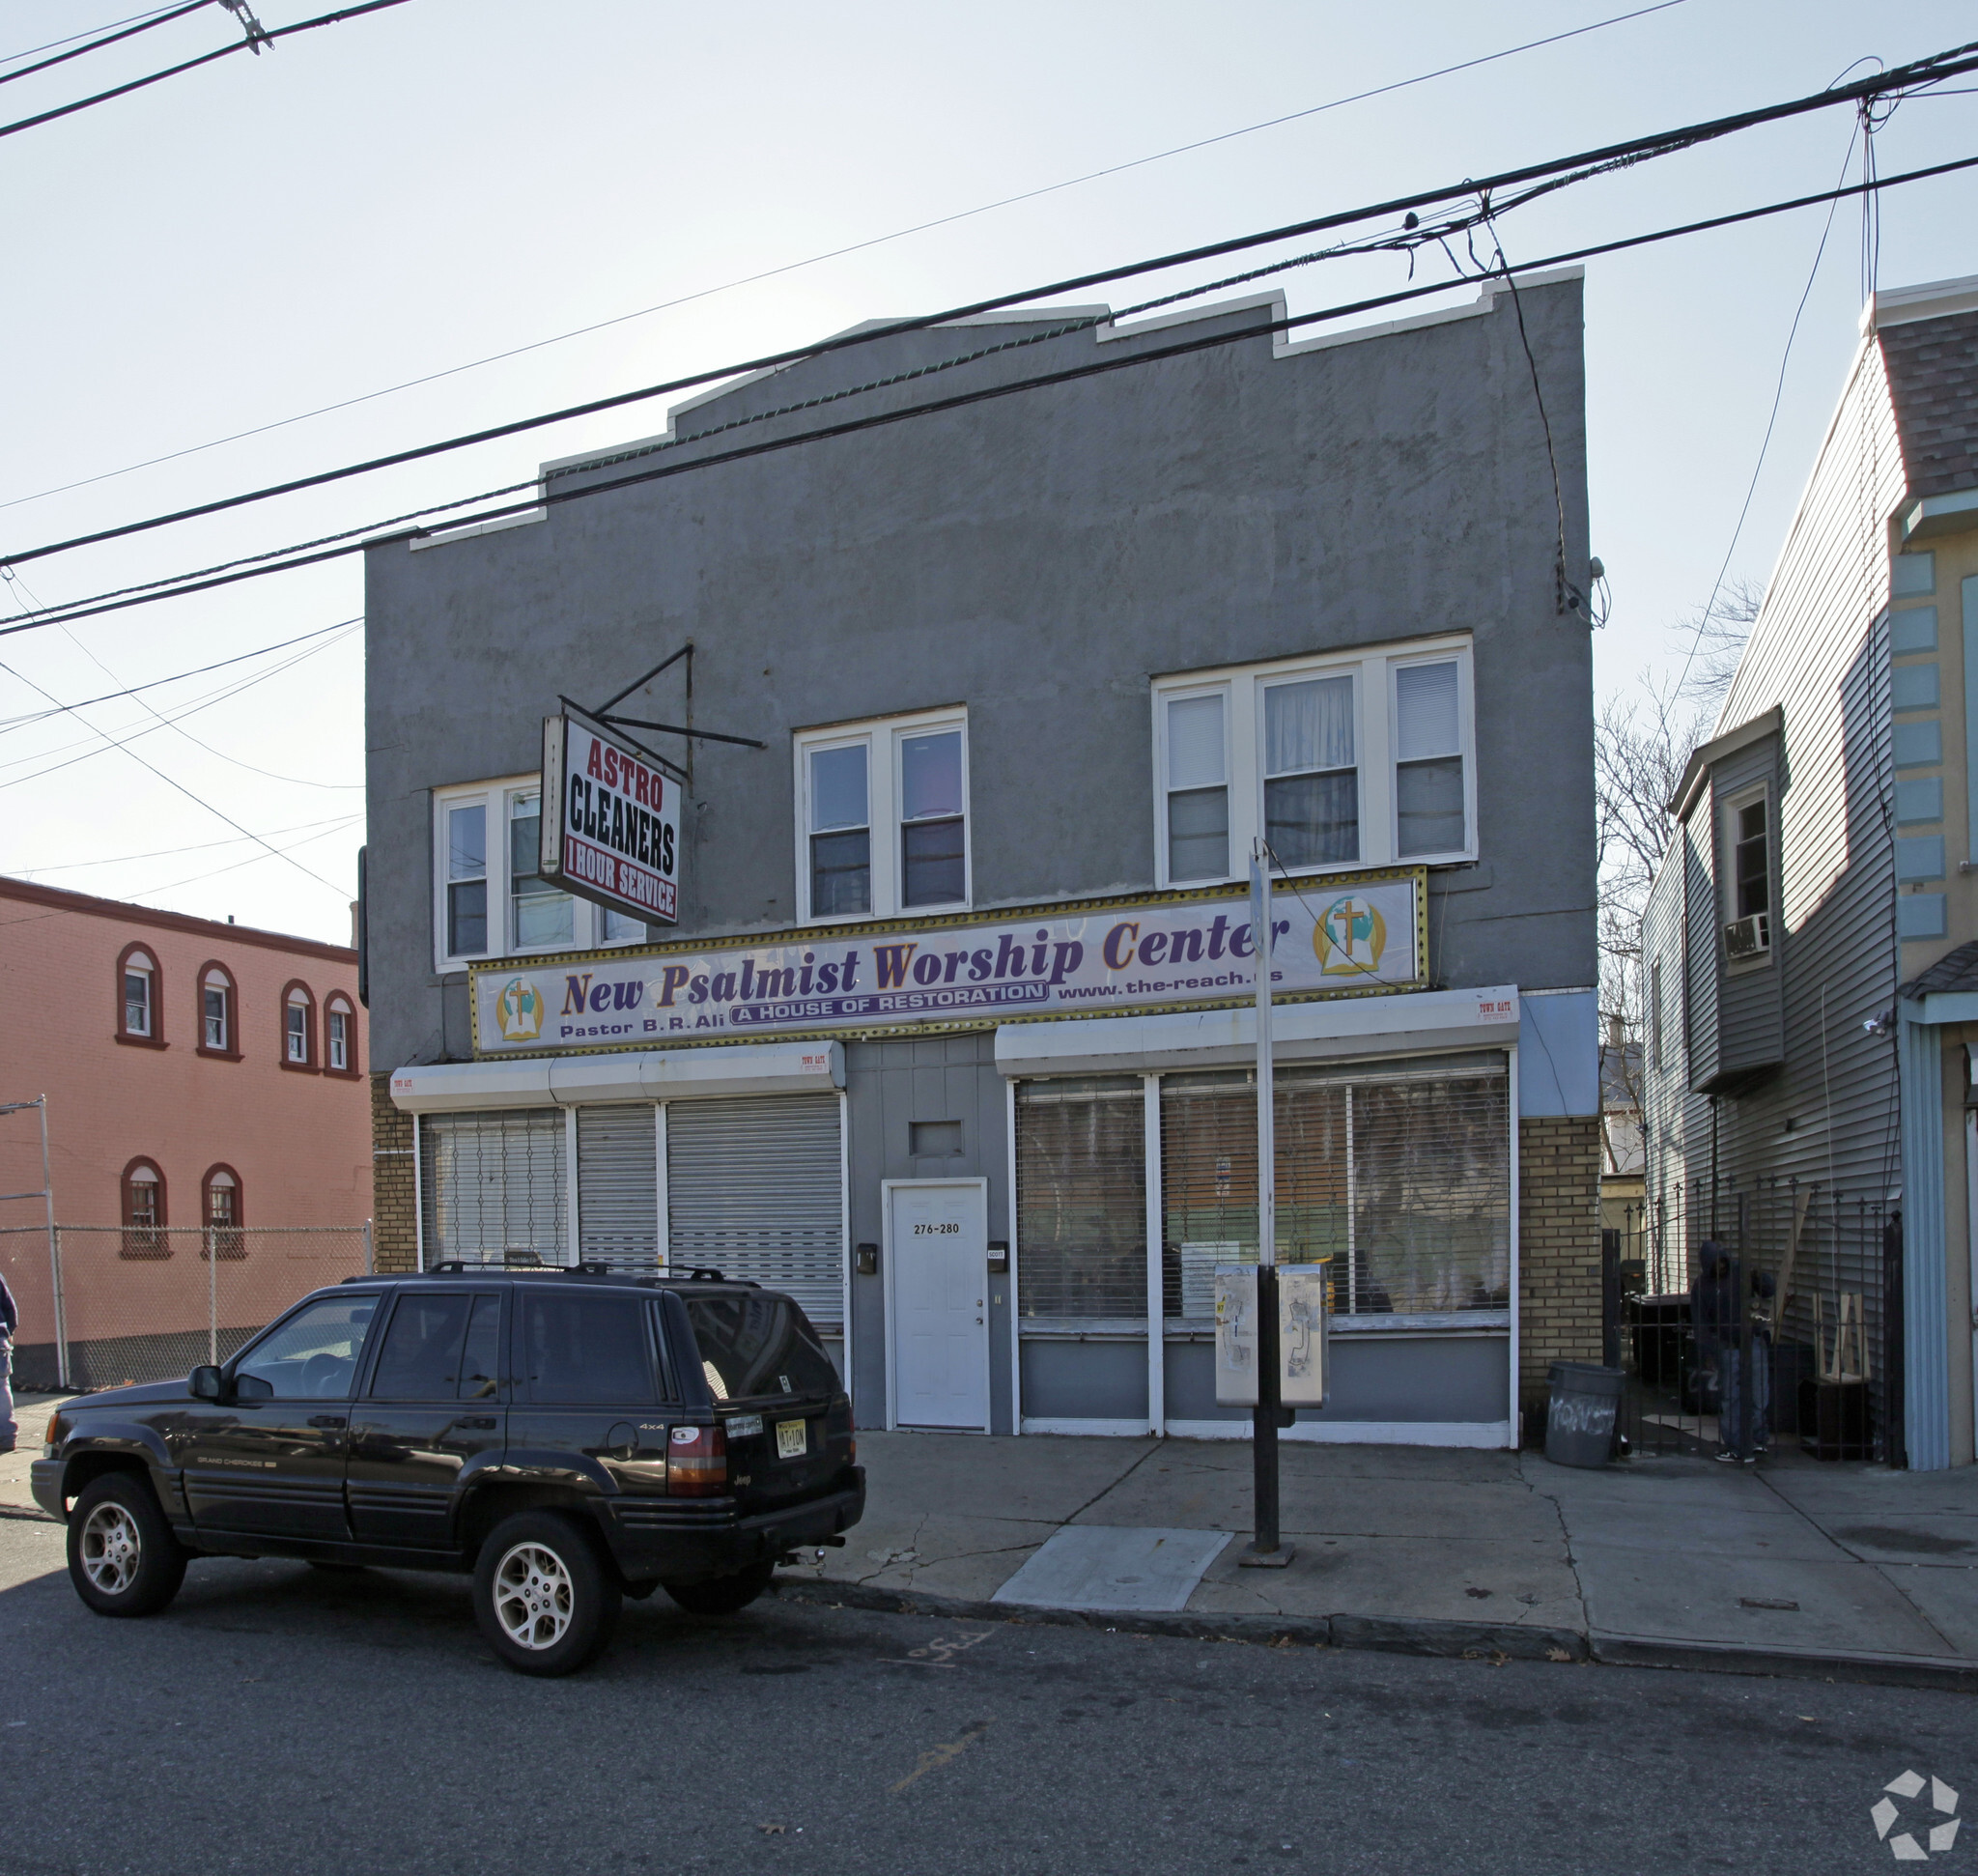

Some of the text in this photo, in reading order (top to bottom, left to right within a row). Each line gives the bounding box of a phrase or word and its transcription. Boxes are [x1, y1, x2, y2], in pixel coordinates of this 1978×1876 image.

[587, 738, 664, 813] ASTRO
[570, 773, 675, 877] CLEANERS
[576, 843, 615, 889] HOUR
[619, 863, 675, 915] SERVICE
[560, 915, 1290, 1015] New Psalmist Worship Center
[1058, 970, 1284, 999] www.the-reach.s
[738, 983, 1044, 1021] A HOUSE OF RESTORATION
[560, 1022, 633, 1037] Pastor
[914, 1223, 960, 1235] 276-280
[223, 1459, 264, 1467] CHEROKEE
[734, 1475, 751, 1487] Jeep
